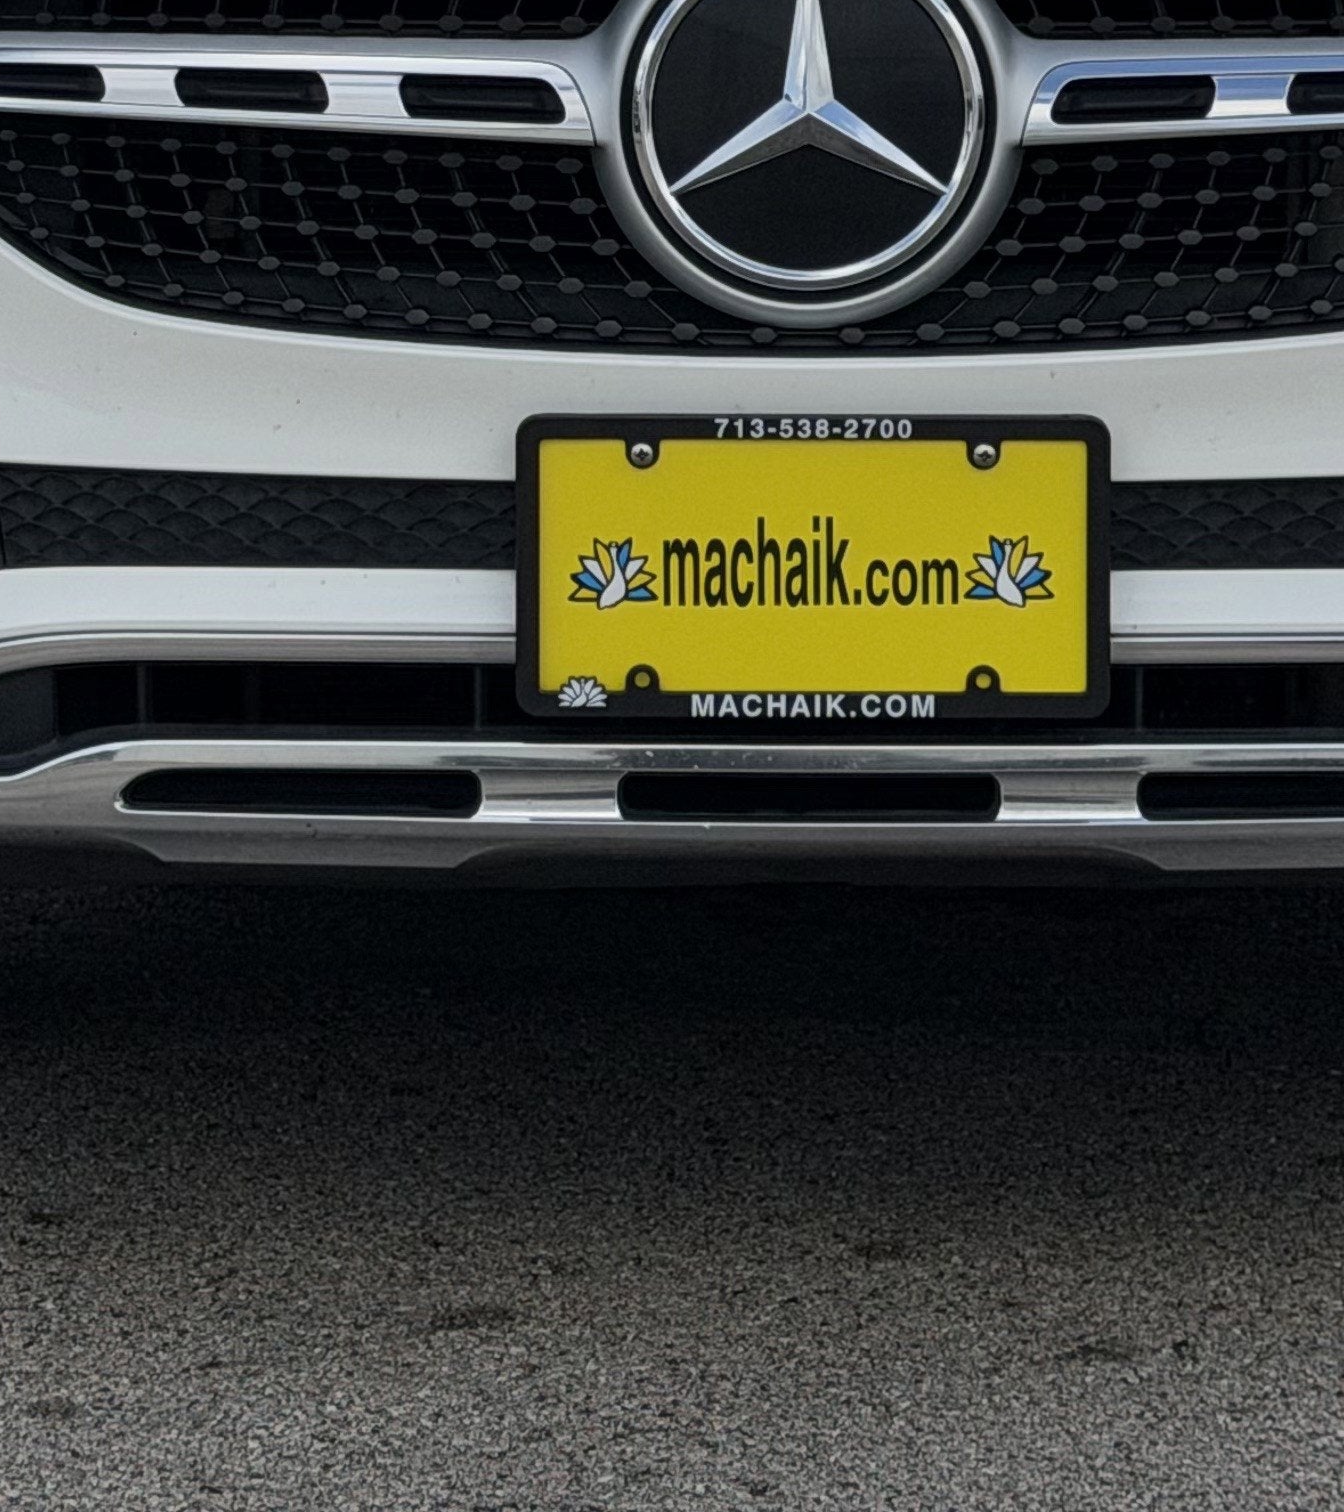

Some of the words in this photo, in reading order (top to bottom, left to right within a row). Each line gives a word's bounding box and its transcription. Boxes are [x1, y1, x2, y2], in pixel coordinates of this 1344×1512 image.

[714, 418, 913, 439] 713-538-2700
[662, 515, 959, 607] machaik.com
[690, 694, 936, 718] MACHAIK.COM
